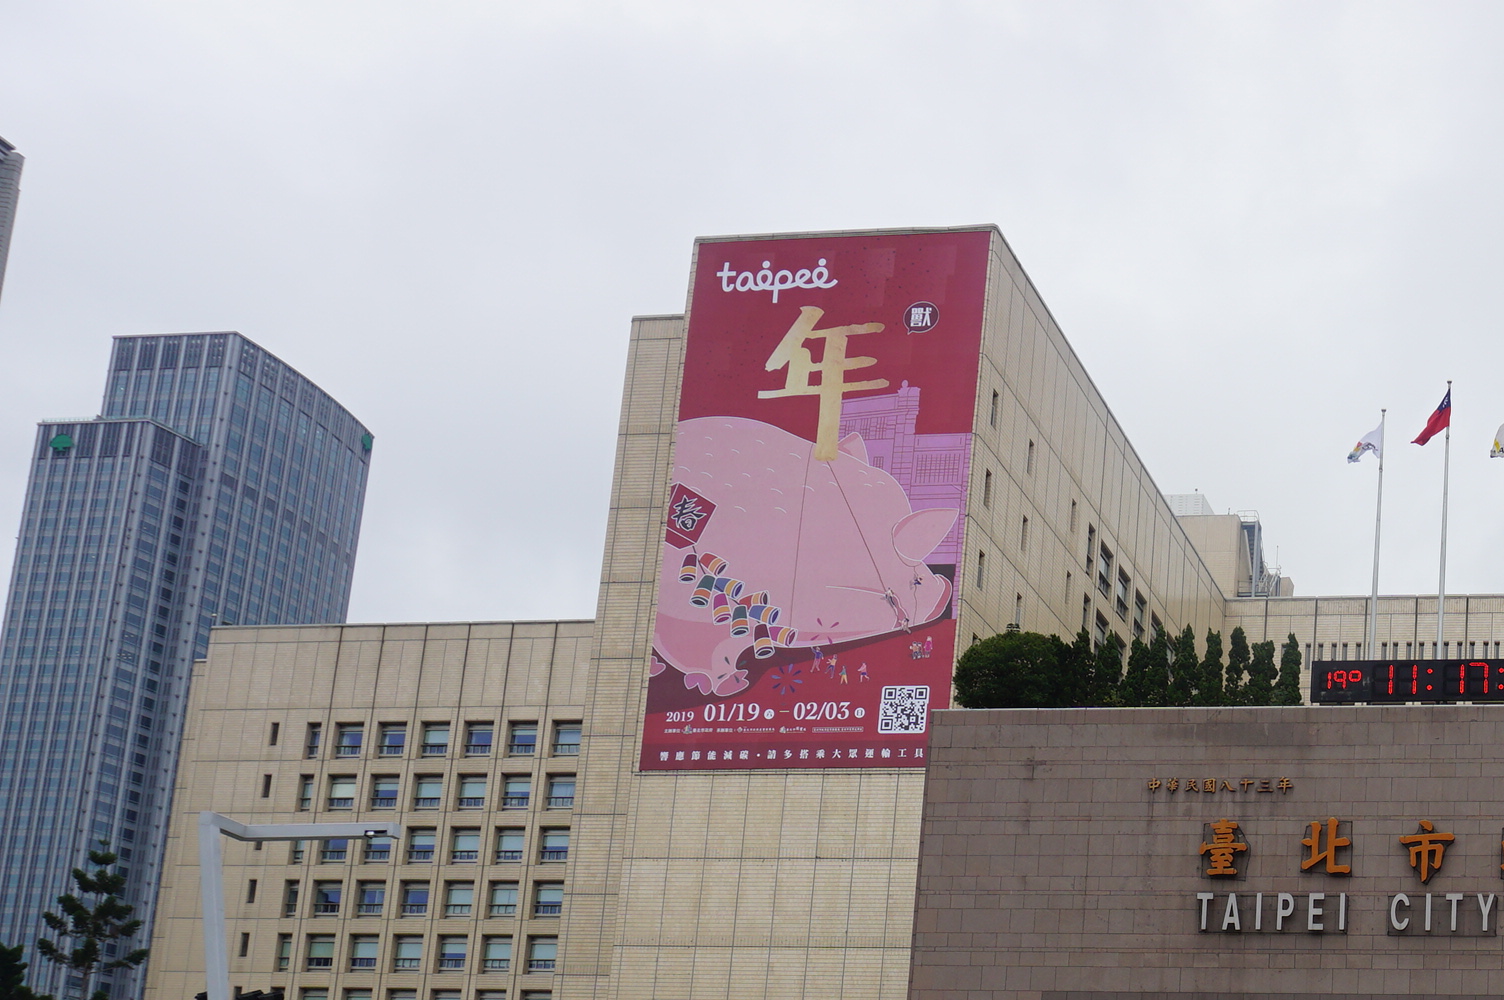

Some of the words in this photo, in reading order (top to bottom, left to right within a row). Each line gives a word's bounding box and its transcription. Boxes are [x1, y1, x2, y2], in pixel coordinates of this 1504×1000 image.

[716, 258, 838, 303] taipei
[757, 306, 890, 461] 年
[671, 496, 707, 532] 春
[666, 710, 695, 723] 2019
[703, 702, 760, 723] 01/19
[792, 701, 851, 721] 02/03
[1147, 776, 1294, 794] 中華民國八十三年
[1197, 892, 1347, 932] TAIPEI
[1390, 893, 1496, 932] CITY
